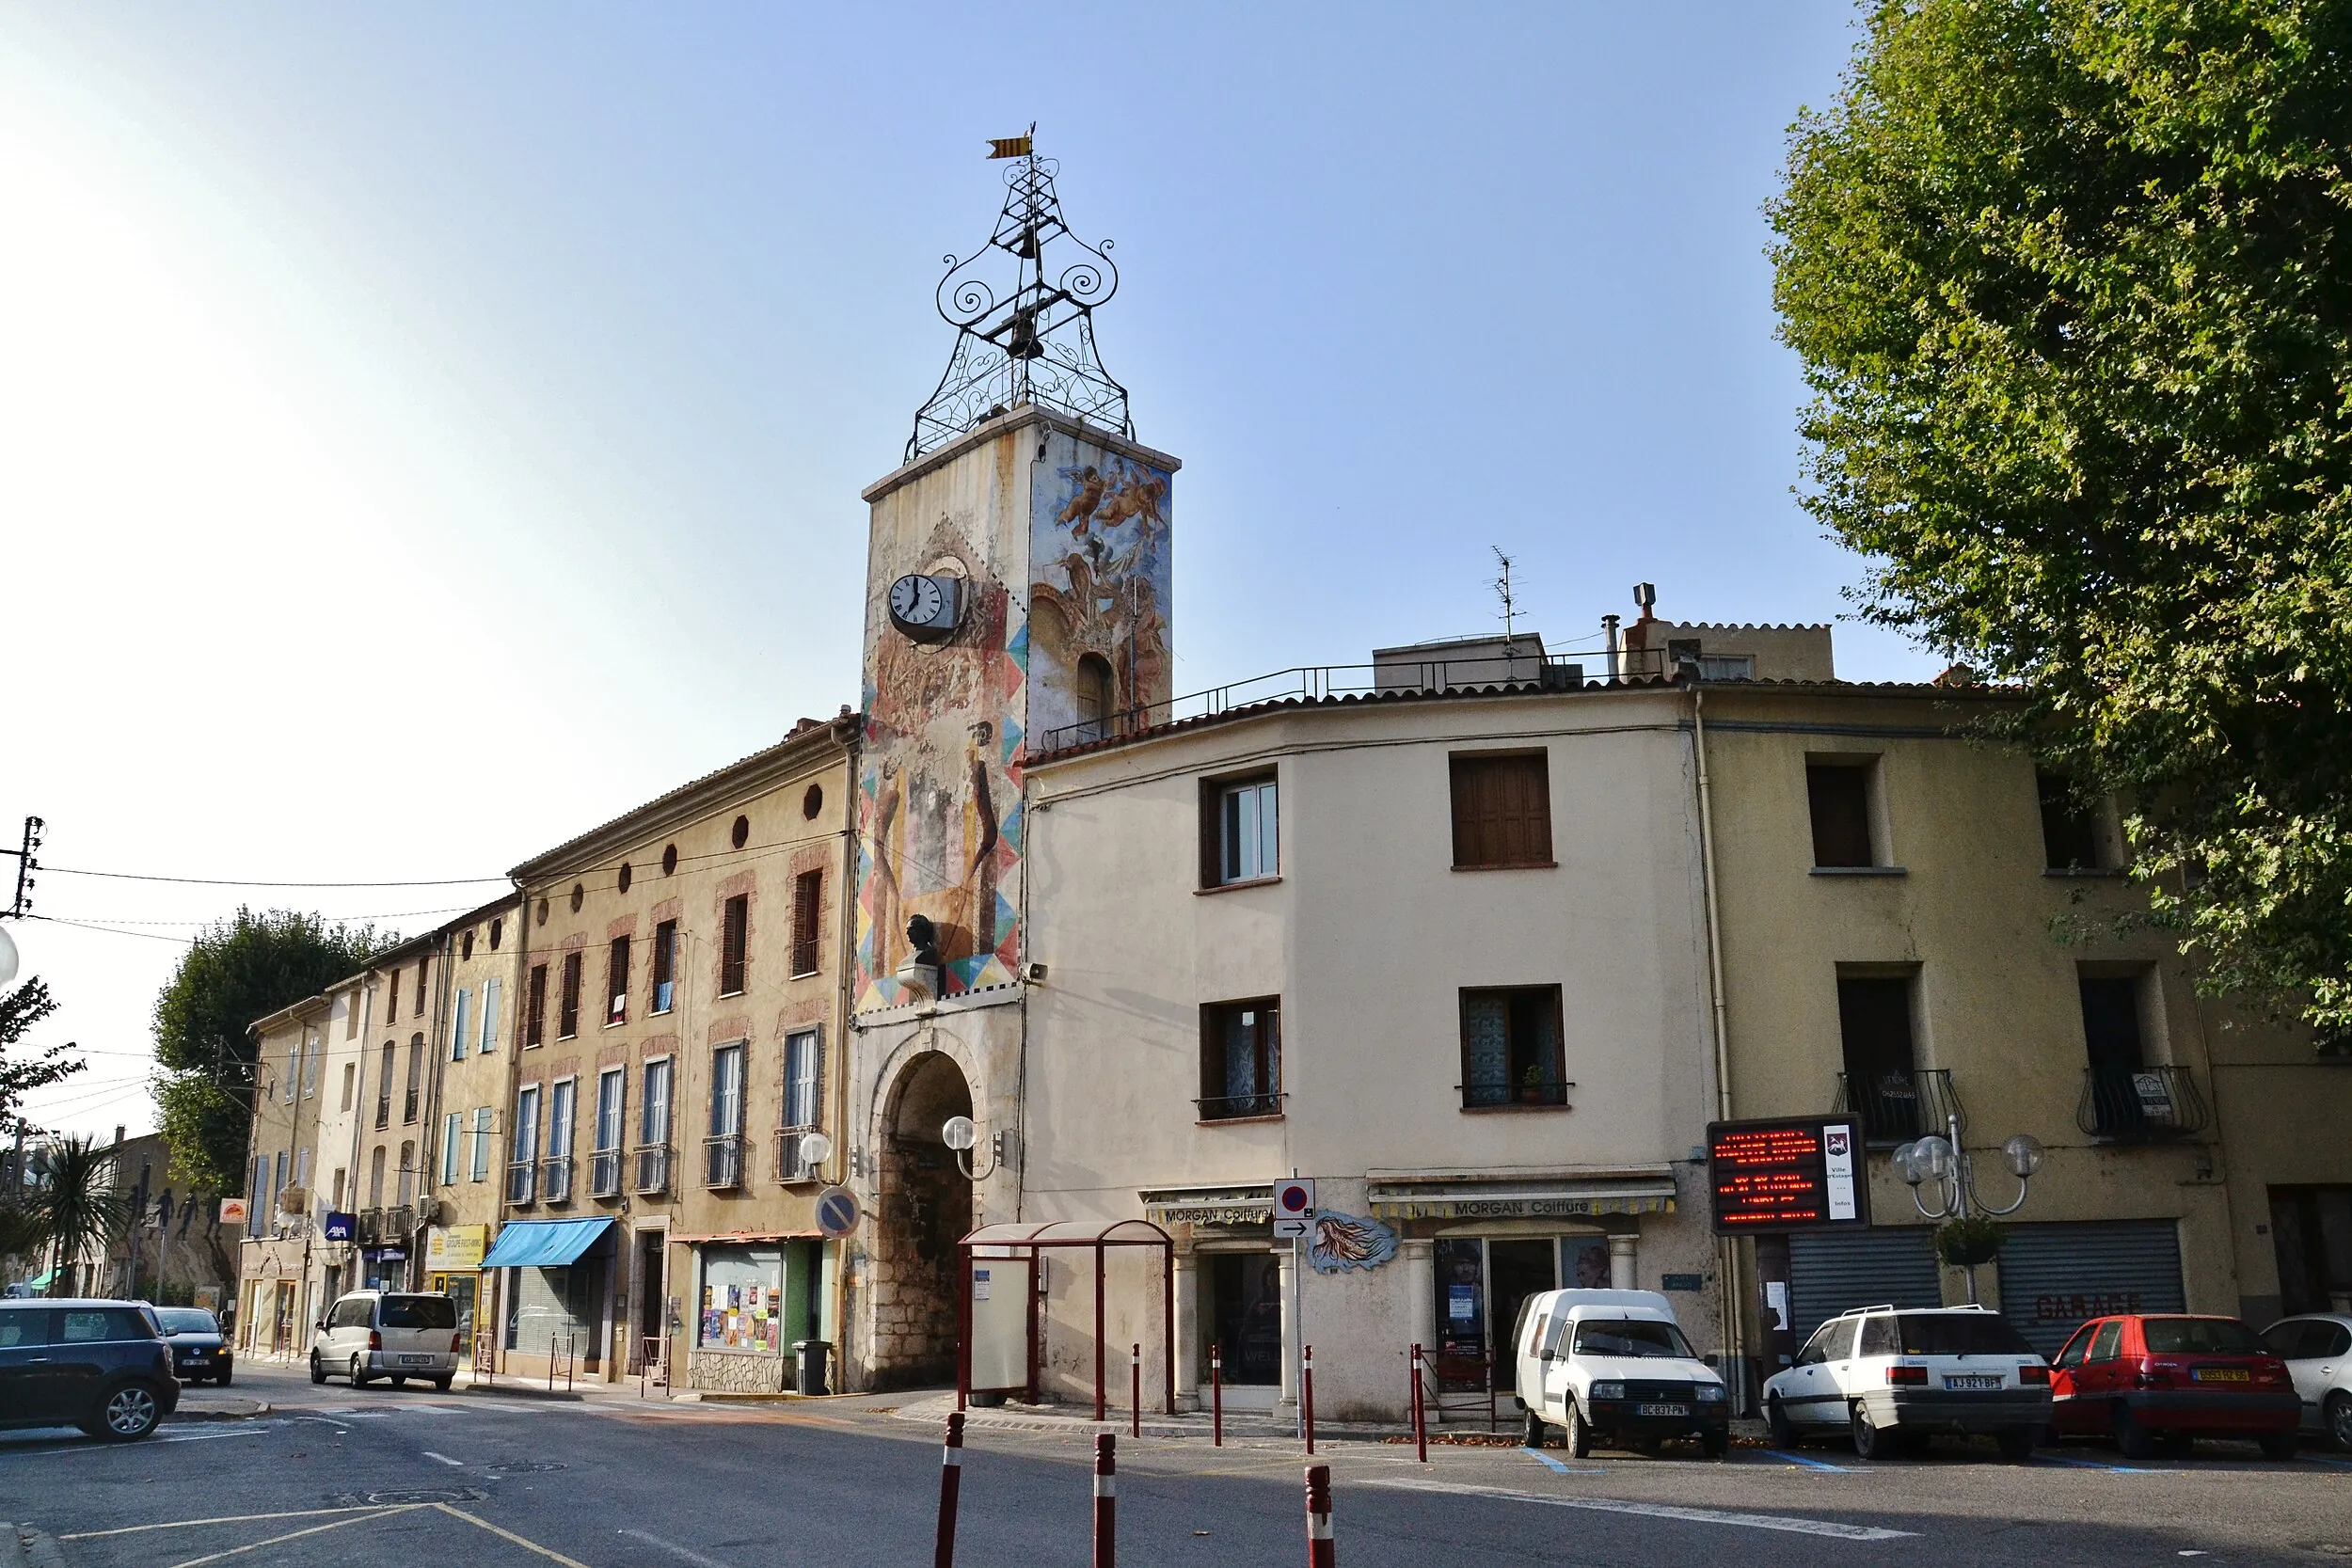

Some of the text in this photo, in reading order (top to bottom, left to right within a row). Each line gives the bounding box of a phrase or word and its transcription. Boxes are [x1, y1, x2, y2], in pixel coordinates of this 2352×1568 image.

[1454, 1200, 1588, 1214] MORGAN Coiffure
[1167, 1208, 1270, 1222] MORGAN Coiffure
[326, 1227, 347, 1238] AXA
[2037, 1293, 2141, 1318] GARAGE
